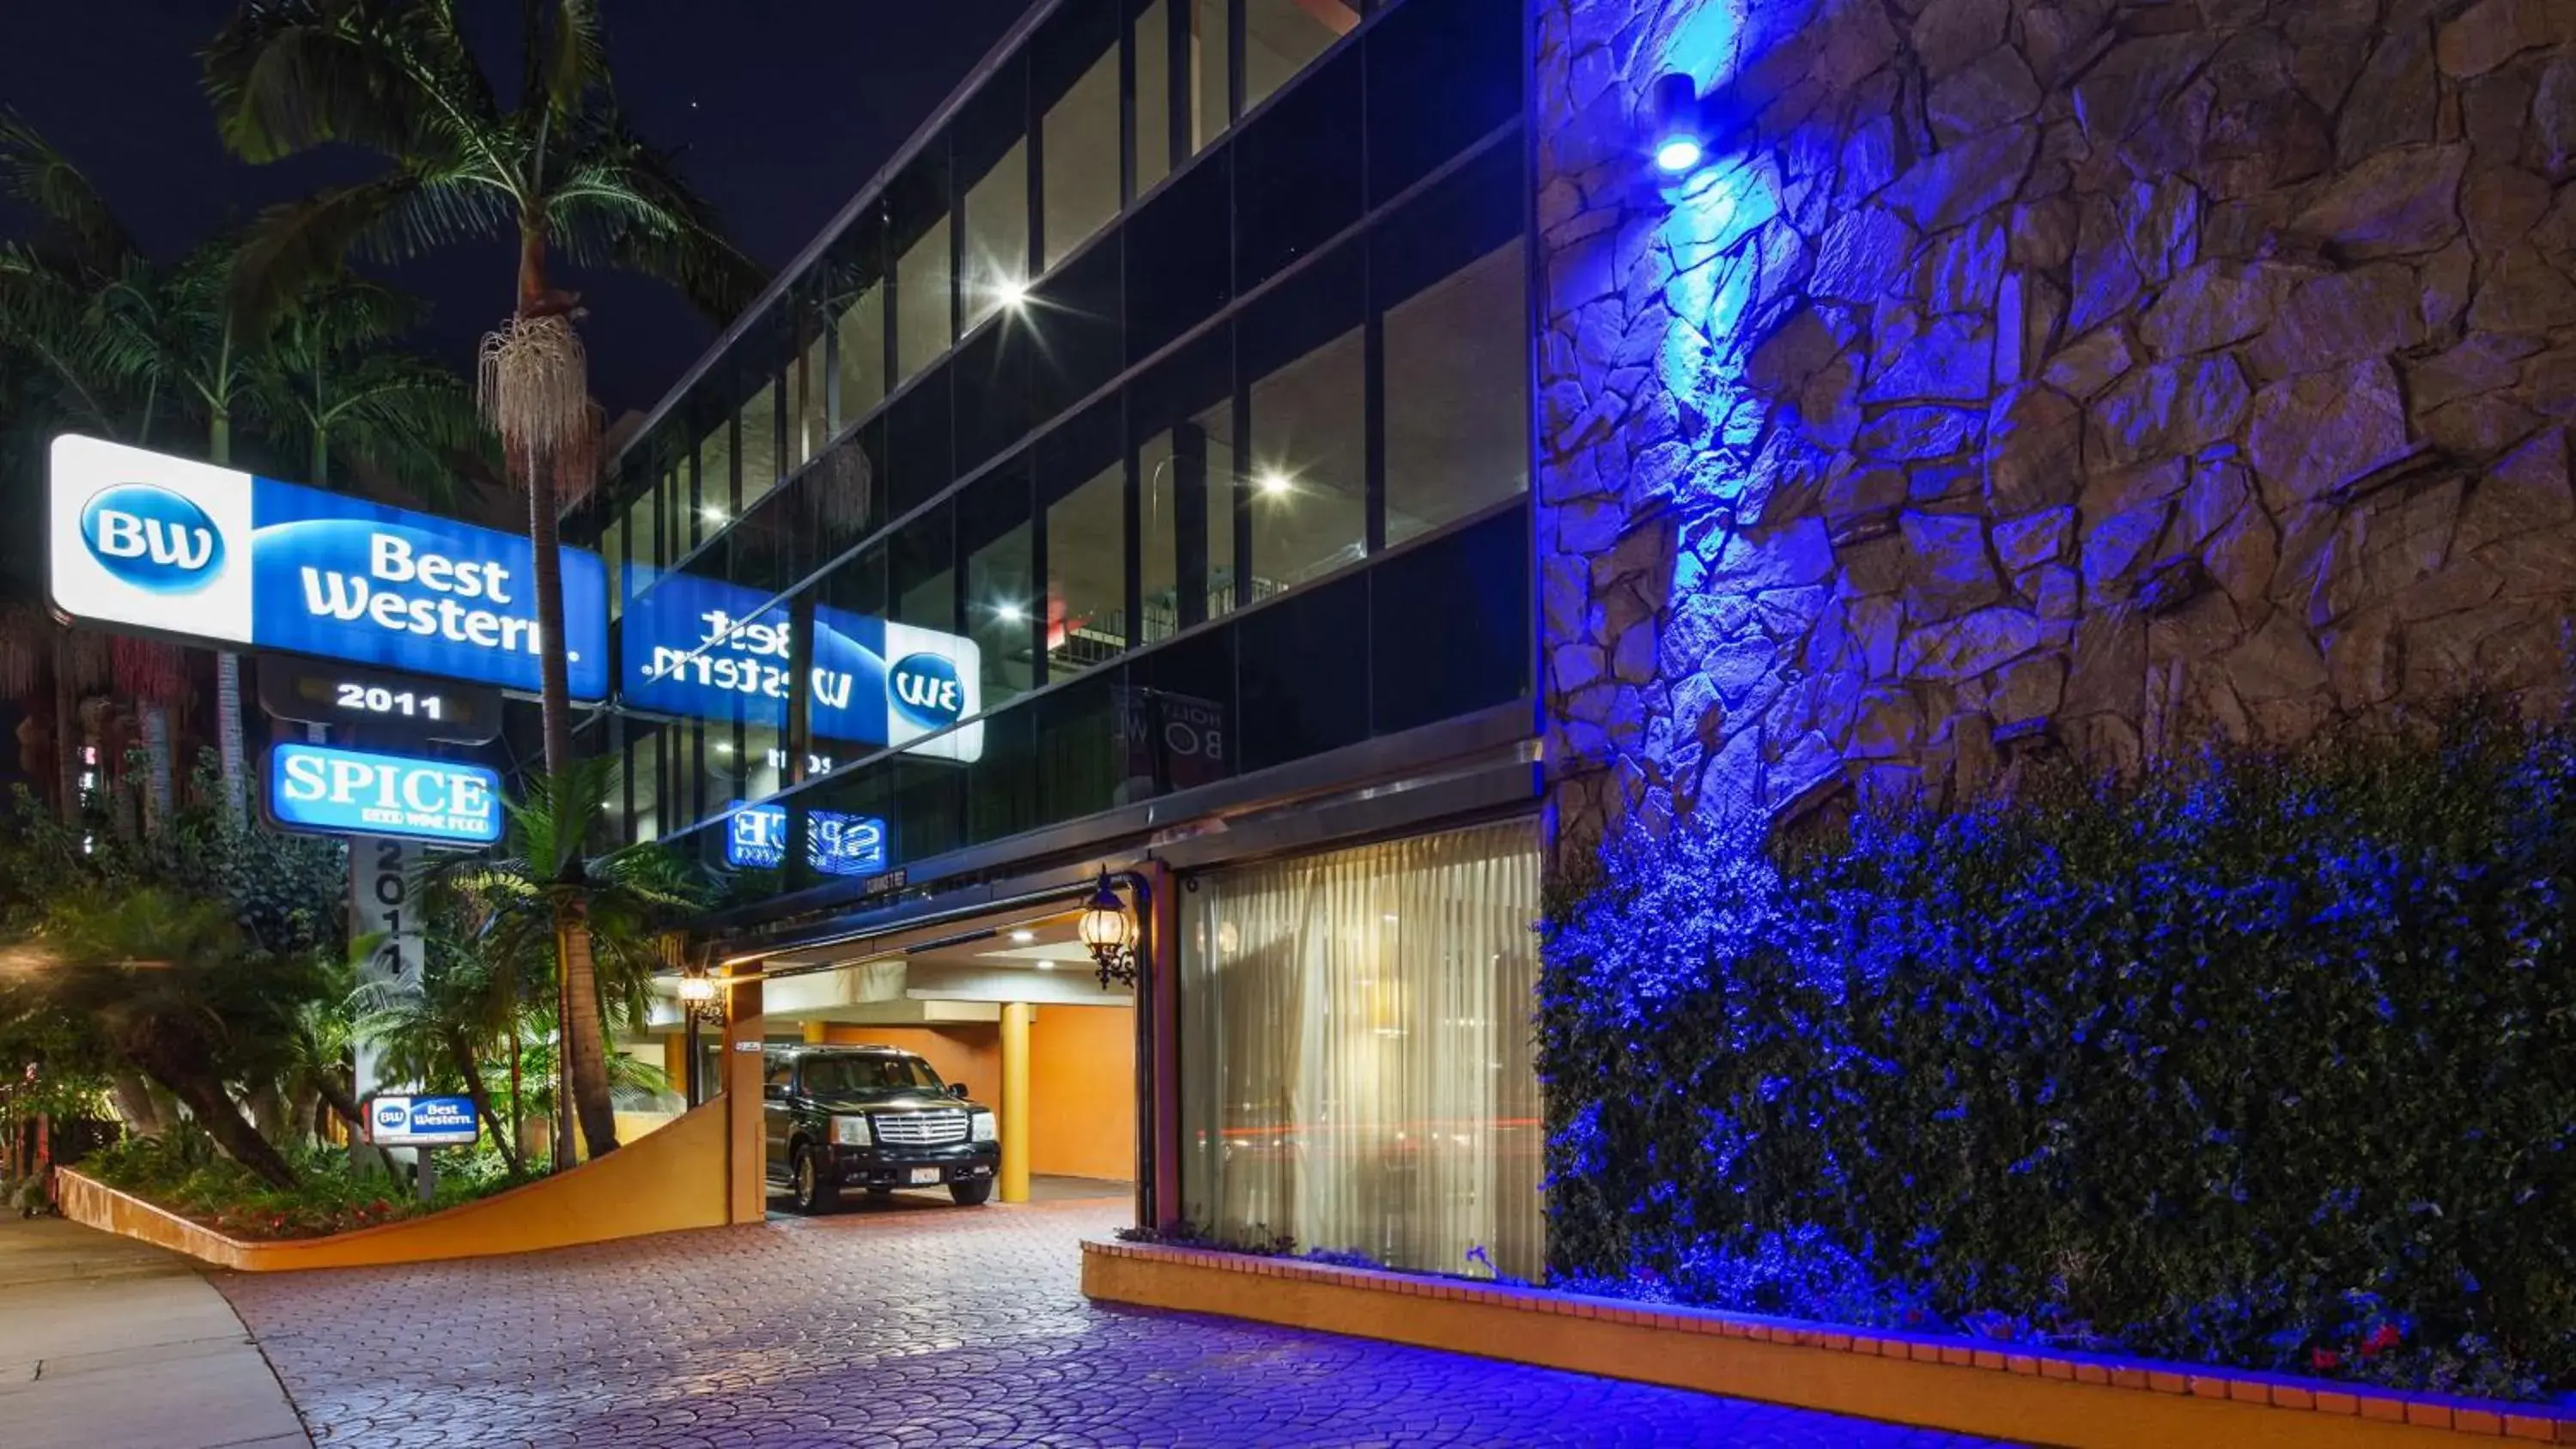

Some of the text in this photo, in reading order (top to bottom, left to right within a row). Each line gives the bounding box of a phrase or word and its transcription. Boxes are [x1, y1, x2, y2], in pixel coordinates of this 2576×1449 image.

[98, 509, 213, 569] BW
[371, 532, 512, 603] Best
[337, 683, 441, 720] 2011
[284, 755, 490, 818] SPICE
[376, 838, 405, 973] 2011
[380, 1111, 404, 1124] BW
[414, 1114, 472, 1126] Western
[428, 1103, 459, 1115] Best
